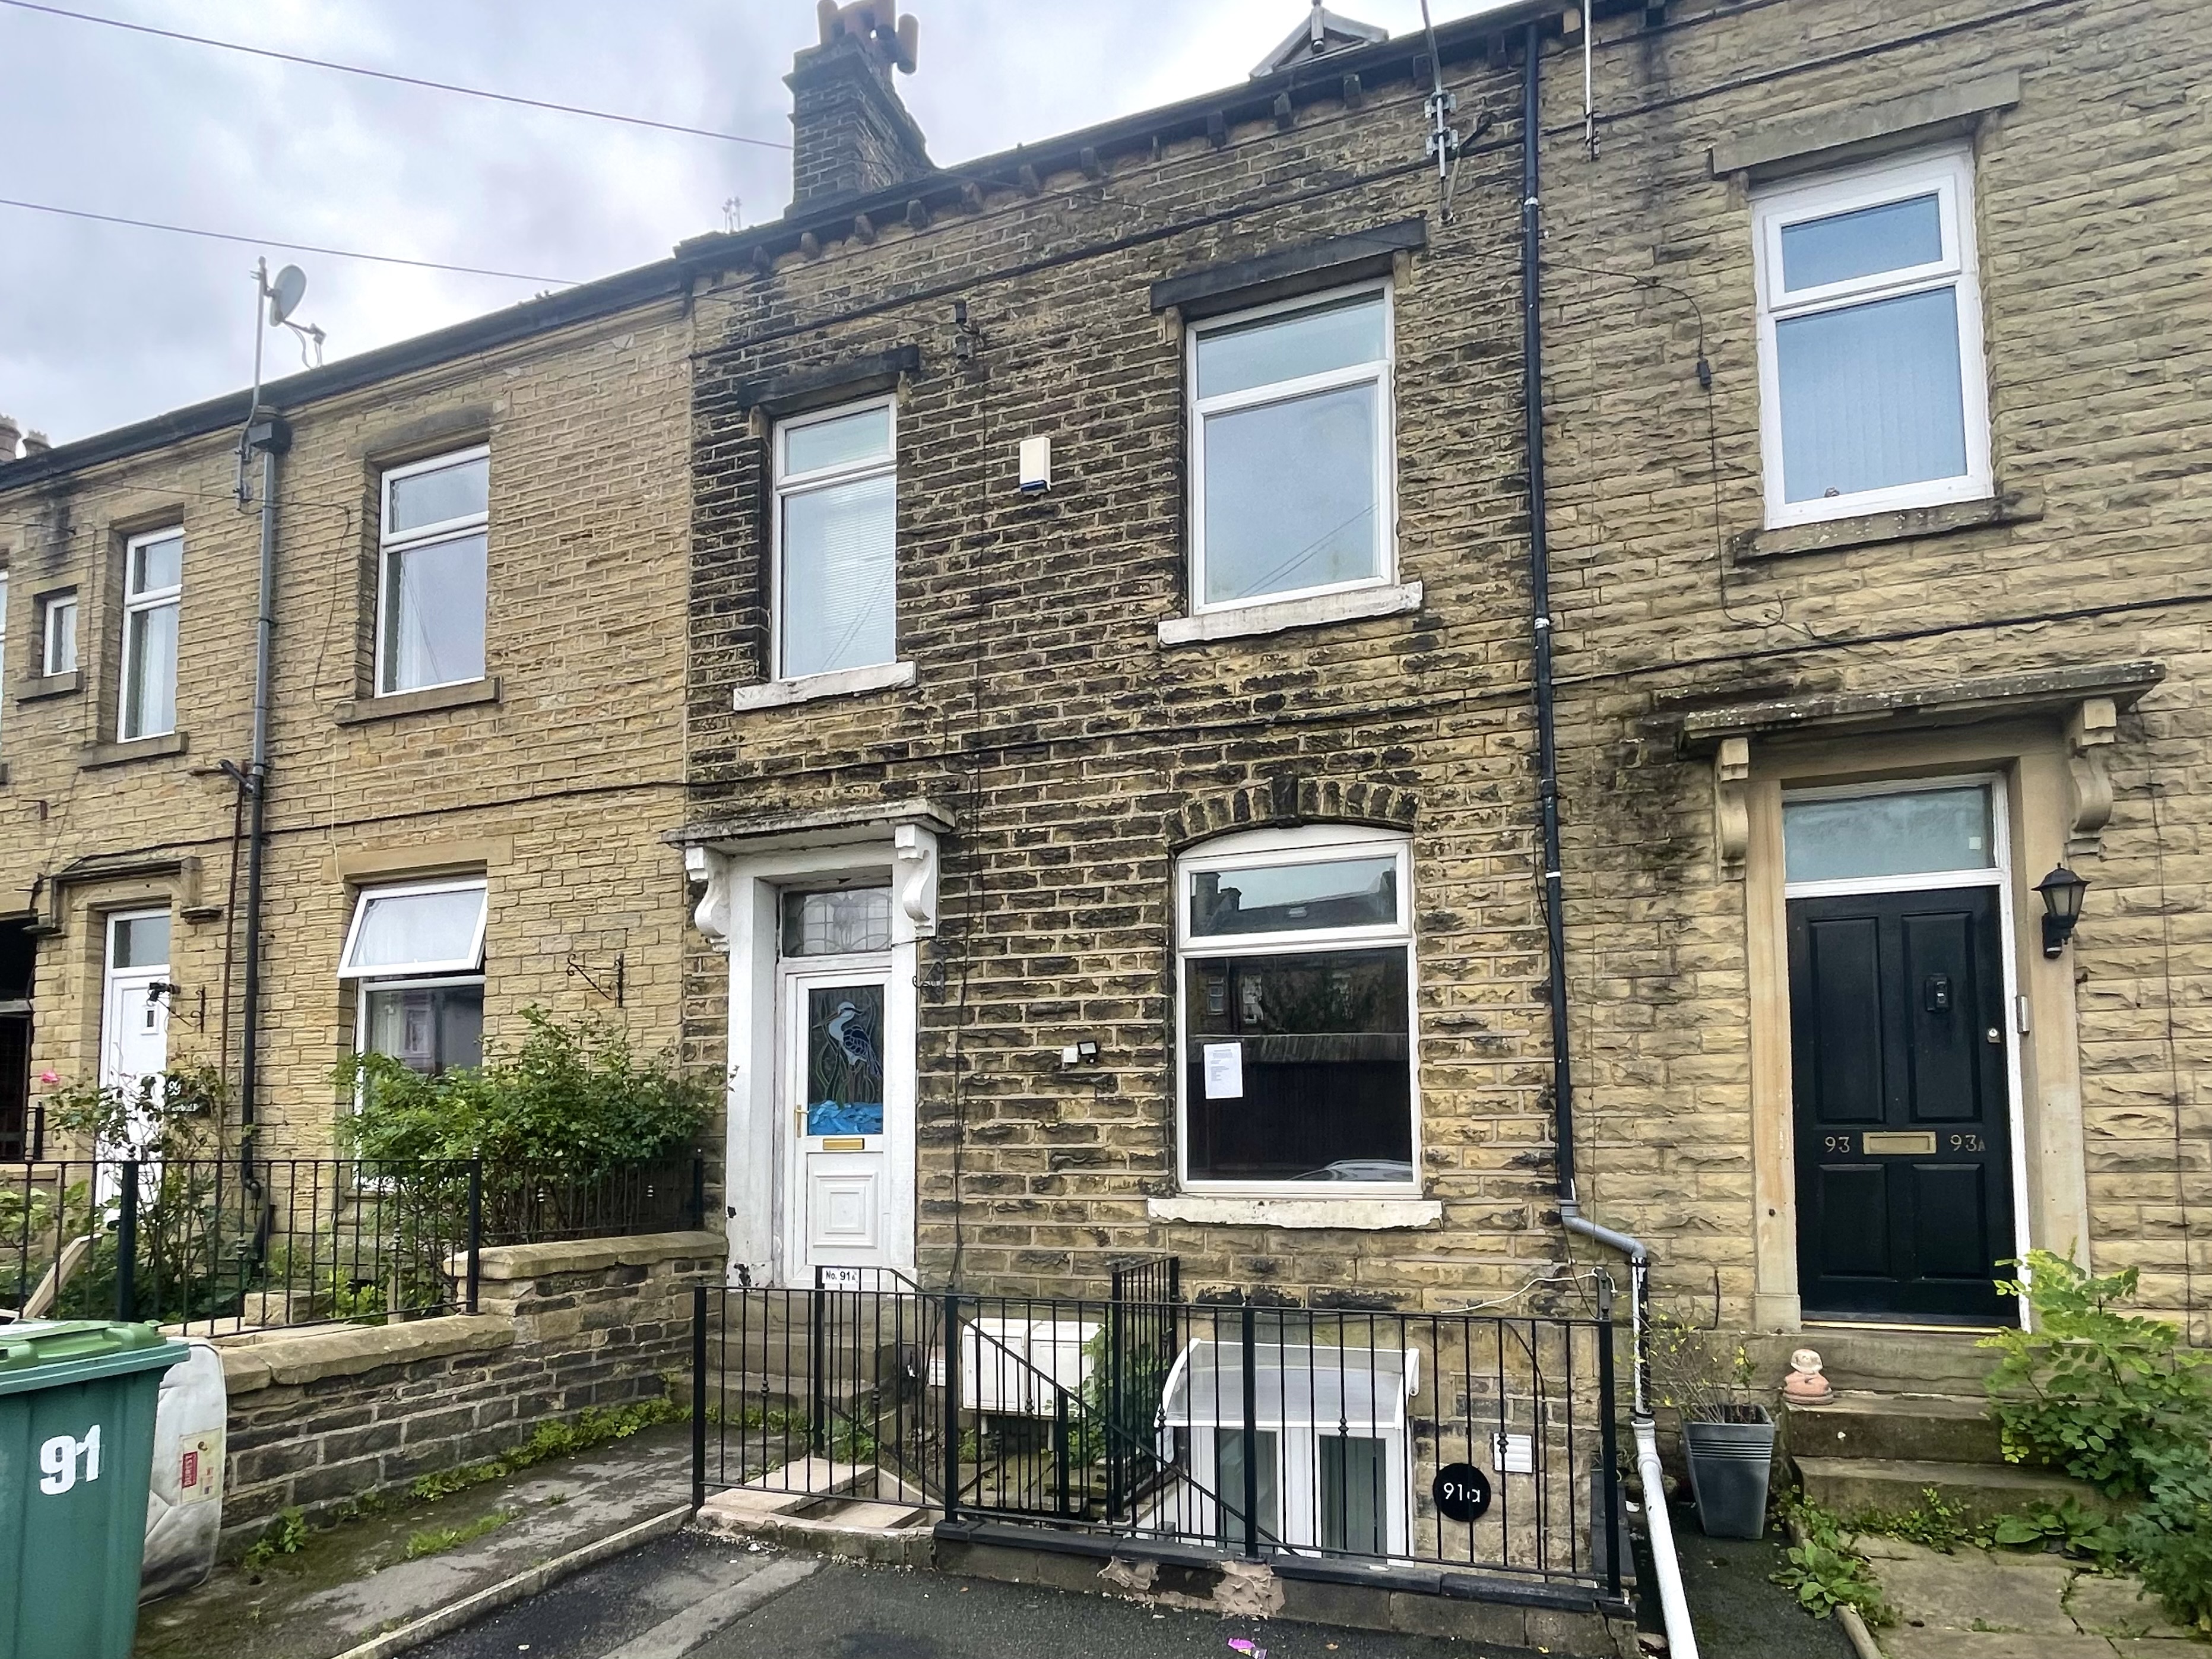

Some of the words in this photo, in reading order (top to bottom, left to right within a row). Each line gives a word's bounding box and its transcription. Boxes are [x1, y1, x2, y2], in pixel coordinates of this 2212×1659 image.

[1824, 1136, 1850, 1153] 93
[1950, 1134, 1986, 1151] 93A
[825, 1270, 837, 1280] No.
[39, 1424, 101, 1495] 91
[1443, 1483, 1481, 1503] 91a
